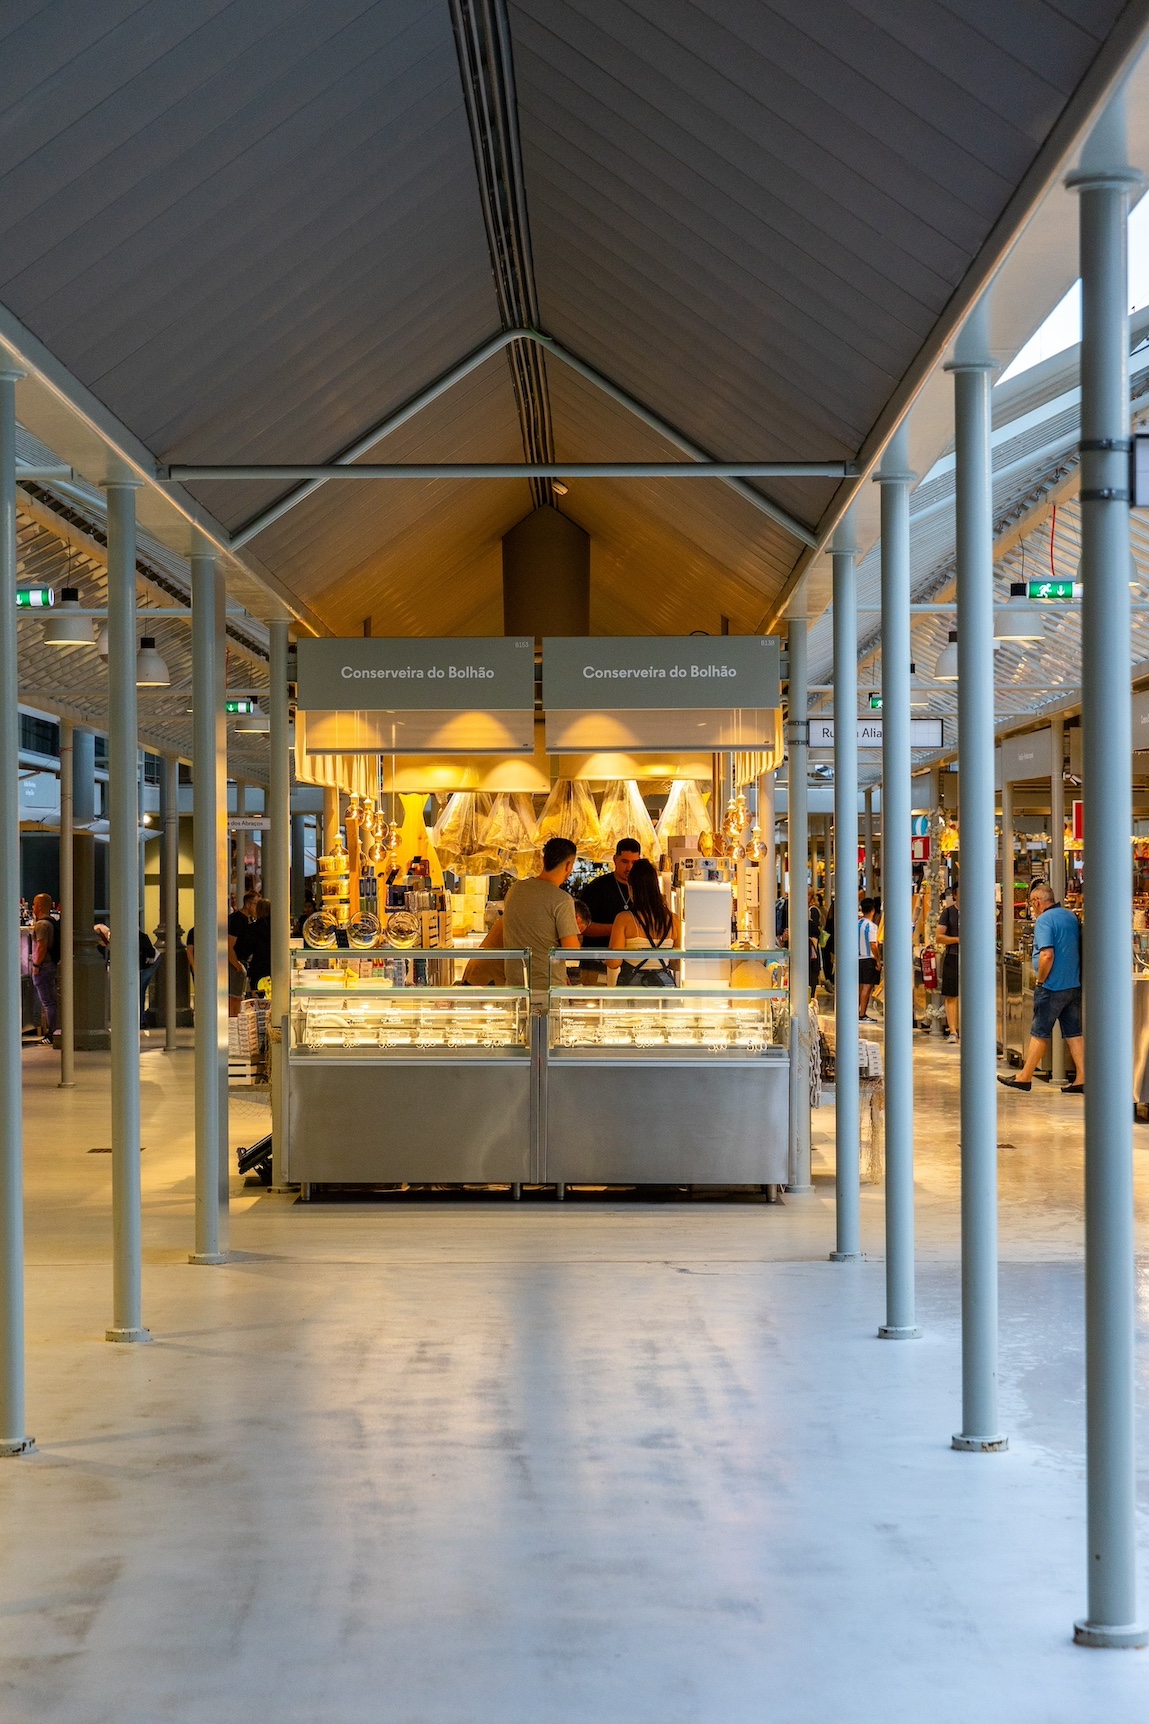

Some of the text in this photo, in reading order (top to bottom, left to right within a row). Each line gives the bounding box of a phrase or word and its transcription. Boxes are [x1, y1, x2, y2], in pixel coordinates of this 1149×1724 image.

[341, 666, 495, 679] Conserveira do Bolhão
[582, 665, 737, 679] Conserveira do Bolhão
[822, 728, 834, 738] Ru
